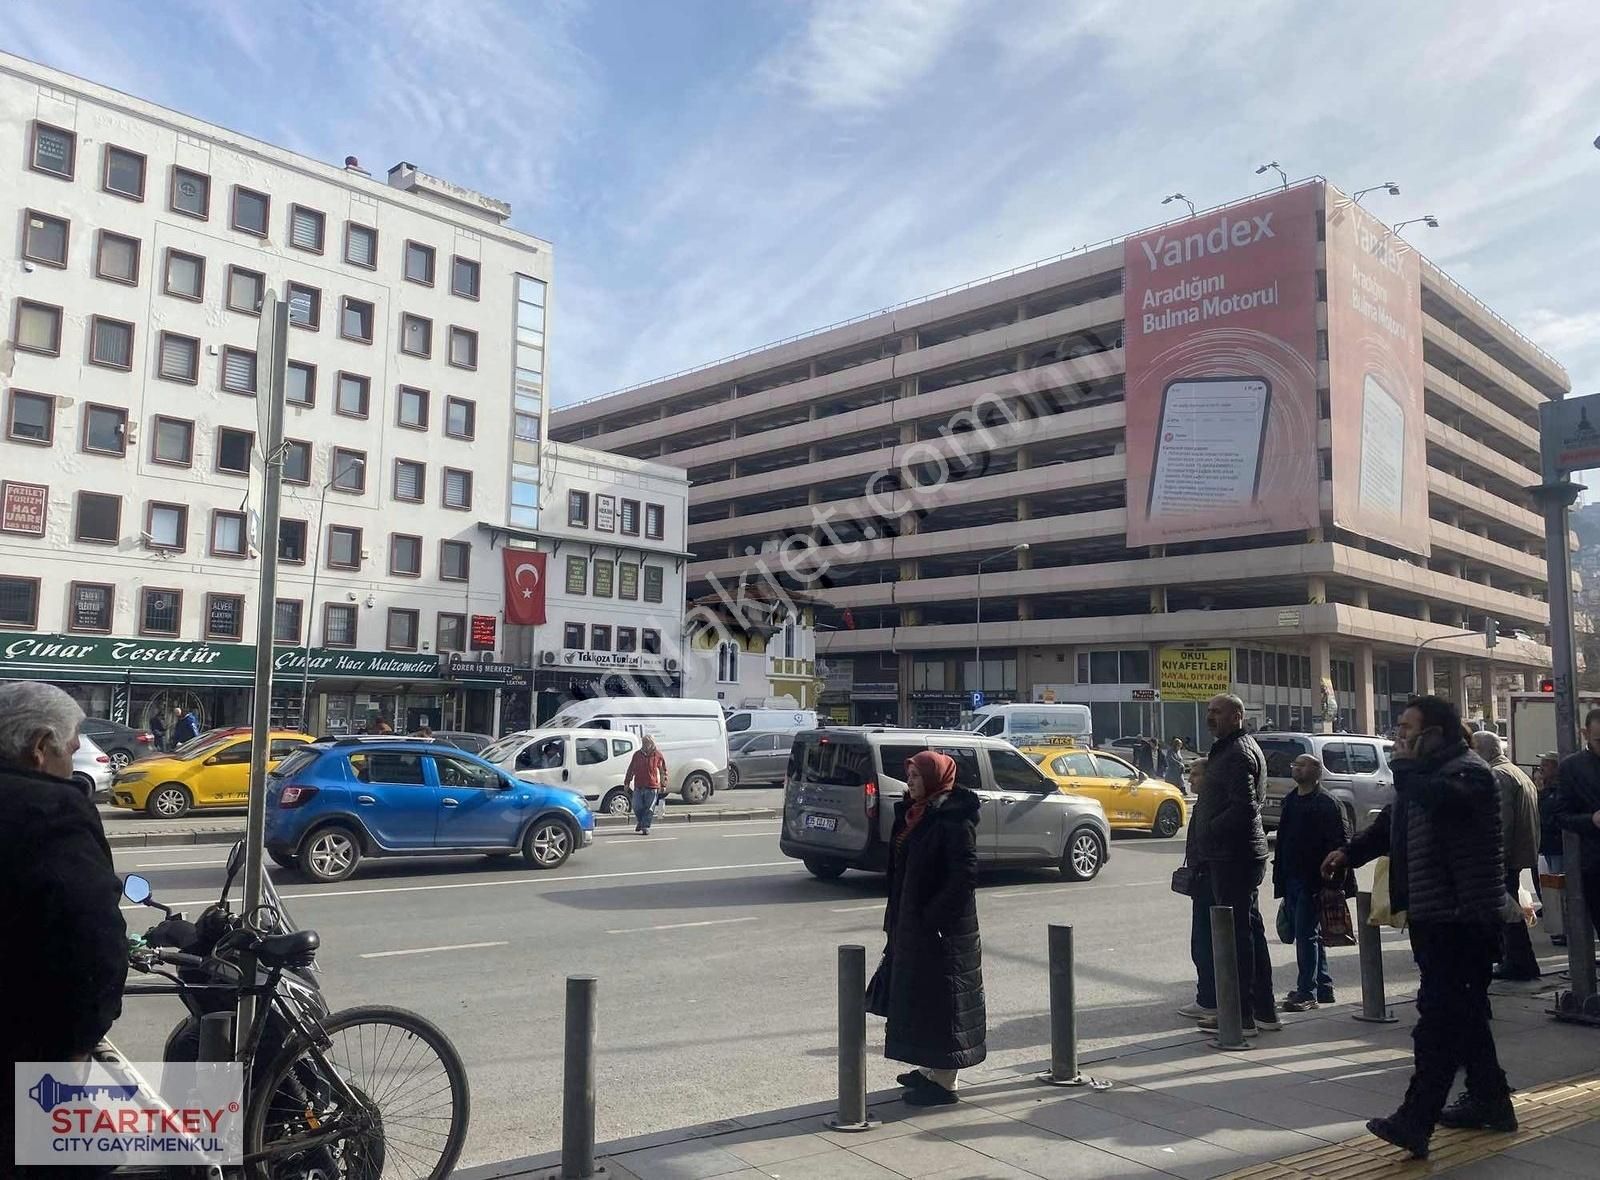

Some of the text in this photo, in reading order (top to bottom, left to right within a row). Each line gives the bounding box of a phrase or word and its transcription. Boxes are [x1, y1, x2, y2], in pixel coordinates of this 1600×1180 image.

[1141, 212, 1275, 272] Yandex
[1142, 274, 1225, 310] Aradığını
[1143, 286, 1274, 334] Bulma Motoru
[13, 504, 38, 514] HAC
[5, 639, 221, 664] Çınar Tesettür
[274, 651, 437, 673] Çınar Hacı Malzemeleri
[1180, 651, 1208, 661] OKUL
[1161, 660, 1228, 672] KIYAFETLERİ
[1161, 671, 1189, 681] HAYAL
